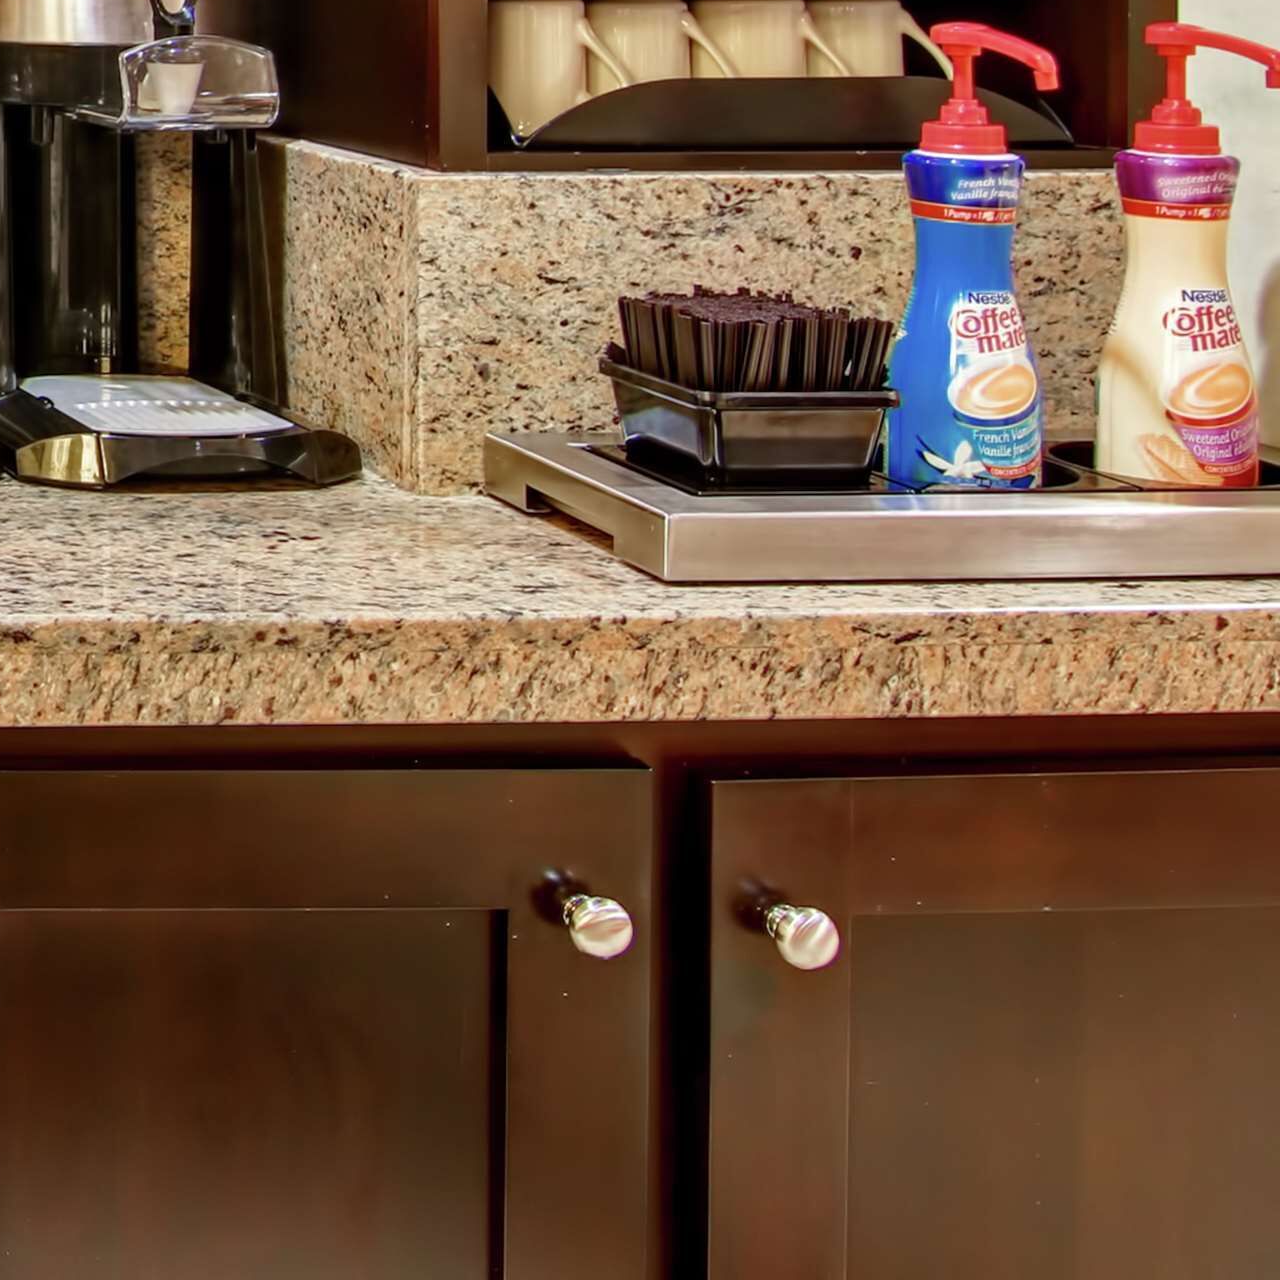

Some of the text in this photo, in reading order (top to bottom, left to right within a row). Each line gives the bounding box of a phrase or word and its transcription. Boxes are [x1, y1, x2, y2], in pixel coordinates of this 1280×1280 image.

[958, 177, 996, 189] French
[1158, 169, 1217, 187] Sweetened
[1161, 184, 1211, 200] Original
[977, 325, 1025, 353] mate
[1190, 323, 1242, 352] mate
[973, 429, 1010, 443] French
[1182, 428, 1230, 444] Sweetened
[1192, 444, 1232, 462] Original
